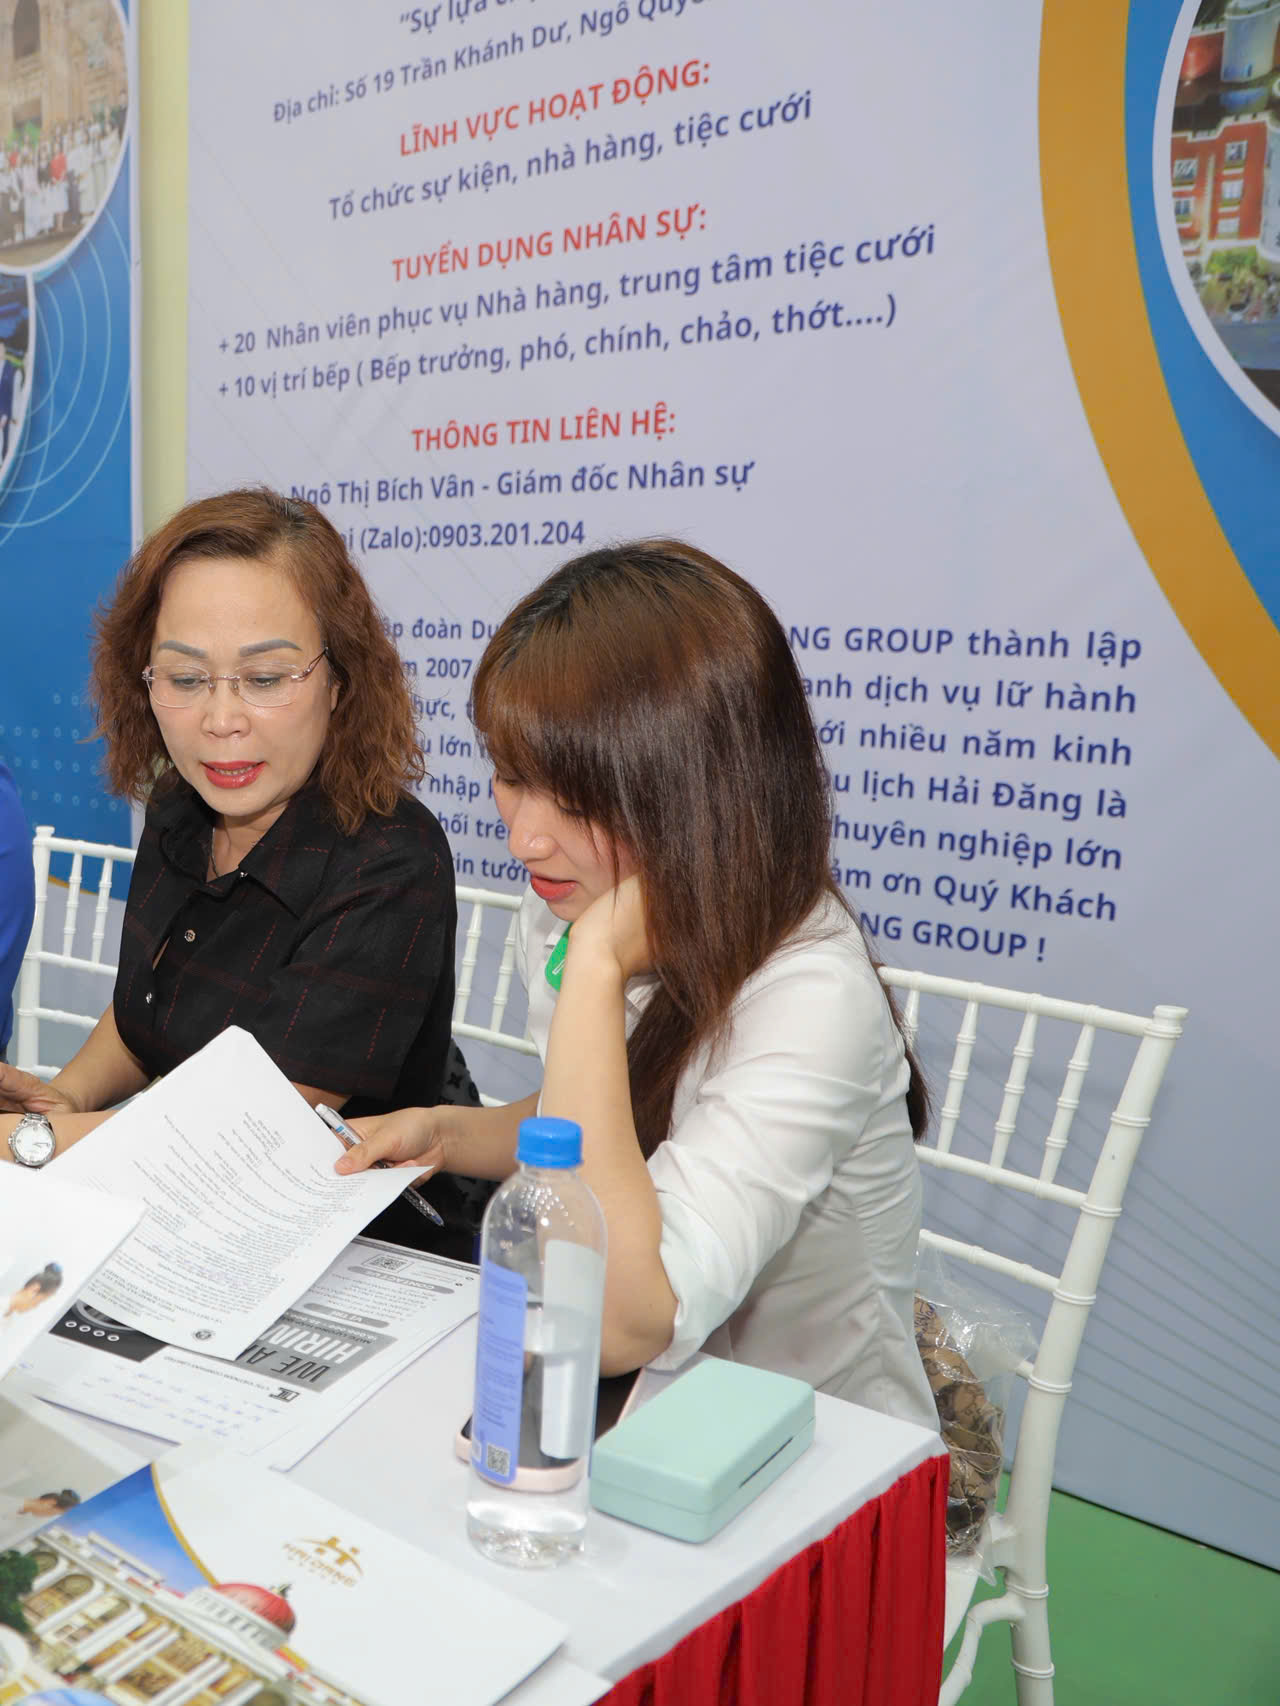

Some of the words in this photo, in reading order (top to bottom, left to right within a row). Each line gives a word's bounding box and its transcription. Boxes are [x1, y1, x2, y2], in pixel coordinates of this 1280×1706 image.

[399, 5, 443, 35] "Sự
[274, 102, 301, 121] Địa
[308, 86, 338, 112] chỉ:
[346, 79, 366, 102] Số
[374, 70, 394, 92] 19
[401, 58, 446, 85] Trần
[454, 32, 523, 71] Khánh
[533, 21, 571, 48] Dư,
[581, 0, 629, 37] Ngô
[400, 120, 457, 156] LĨNH
[466, 105, 520, 141] VỰC
[528, 83, 604, 125] HOẠT
[611, 59, 710, 105] ĐỘNG:
[330, 194, 353, 219] Tổ
[361, 184, 414, 212] chức
[422, 175, 452, 202] sự
[459, 161, 517, 192] kiện,
[528, 144, 575, 177] nhà
[586, 132, 662, 165] hàng,
[674, 112, 729, 148] tiệc
[739, 90, 811, 132] cưới
[478, 232, 552, 270] DỤNG
[563, 212, 646, 253] NHÂN
[656, 203, 706, 240] SỰ:
[234, 332, 255, 354] 20
[267, 322, 319, 348] Nhân
[326, 314, 370, 339] viên
[378, 307, 432, 339] phục
[440, 302, 467, 326] vụ
[477, 287, 526, 318] Nhà
[536, 281, 609, 309] hàng,
[620, 267, 700, 297] trung
[711, 254, 772, 284] tâm
[784, 241, 844, 278] tiệc
[855, 224, 934, 264] cưới
[236, 376, 255, 397] 10
[261, 372, 276, 398] vị
[283, 367, 307, 392] trí
[312, 364, 350, 392] bếp
[371, 356, 410, 384] Bếp
[418, 344, 510, 375] trưởng,
[520, 333, 575, 371] phó,
[585, 322, 669, 355] chính,
[681, 310, 760, 344] chảo,
[772, 294, 896, 334] thớt....)
[411, 420, 498, 451] THÔNG
[506, 418, 550, 445] TIN
[560, 407, 621, 440] LIÊN
[632, 401, 675, 441] HỆ:
[337, 480, 369, 508] Thị
[377, 477, 422, 502] Bích
[430, 474, 474, 499] Vân
[497, 469, 562, 496] Giám
[571, 464, 618, 493] đốc
[629, 461, 704, 490] Nhân
[715, 461, 755, 492] sự
[360, 521, 584, 554] (Zalo):0903.201.204
[412, 617, 463, 640] đoàn
[844, 627, 954, 654] GROUP
[968, 629, 1069, 658] thành
[1086, 631, 1141, 668] lập
[864, 675, 928, 707] dịch
[942, 684, 980, 712] vụ
[996, 680, 1034, 708] lữ
[1045, 682, 1136, 713] hành
[439, 734, 472, 757] lớn
[860, 723, 946, 753] nhiều
[963, 730, 1035, 760] năm
[1053, 734, 1131, 766] kinh
[429, 773, 480, 803] nhập
[862, 770, 914, 802] lịch
[928, 775, 979, 805] Hải
[992, 782, 1082, 822] Đăng
[1097, 789, 1127, 818] là
[476, 818, 510, 840] trê
[833, 814, 926, 851] huyên
[938, 829, 1052, 869] nghiệp
[1065, 838, 1121, 870] lớn
[882, 872, 921, 896] ơn
[934, 875, 999, 912] Quý
[1010, 884, 1116, 921] Khách
[912, 920, 1027, 957] GROUP
[259, 1323, 364, 1365] HIRIN
[271, 1354, 331, 1384] WE
